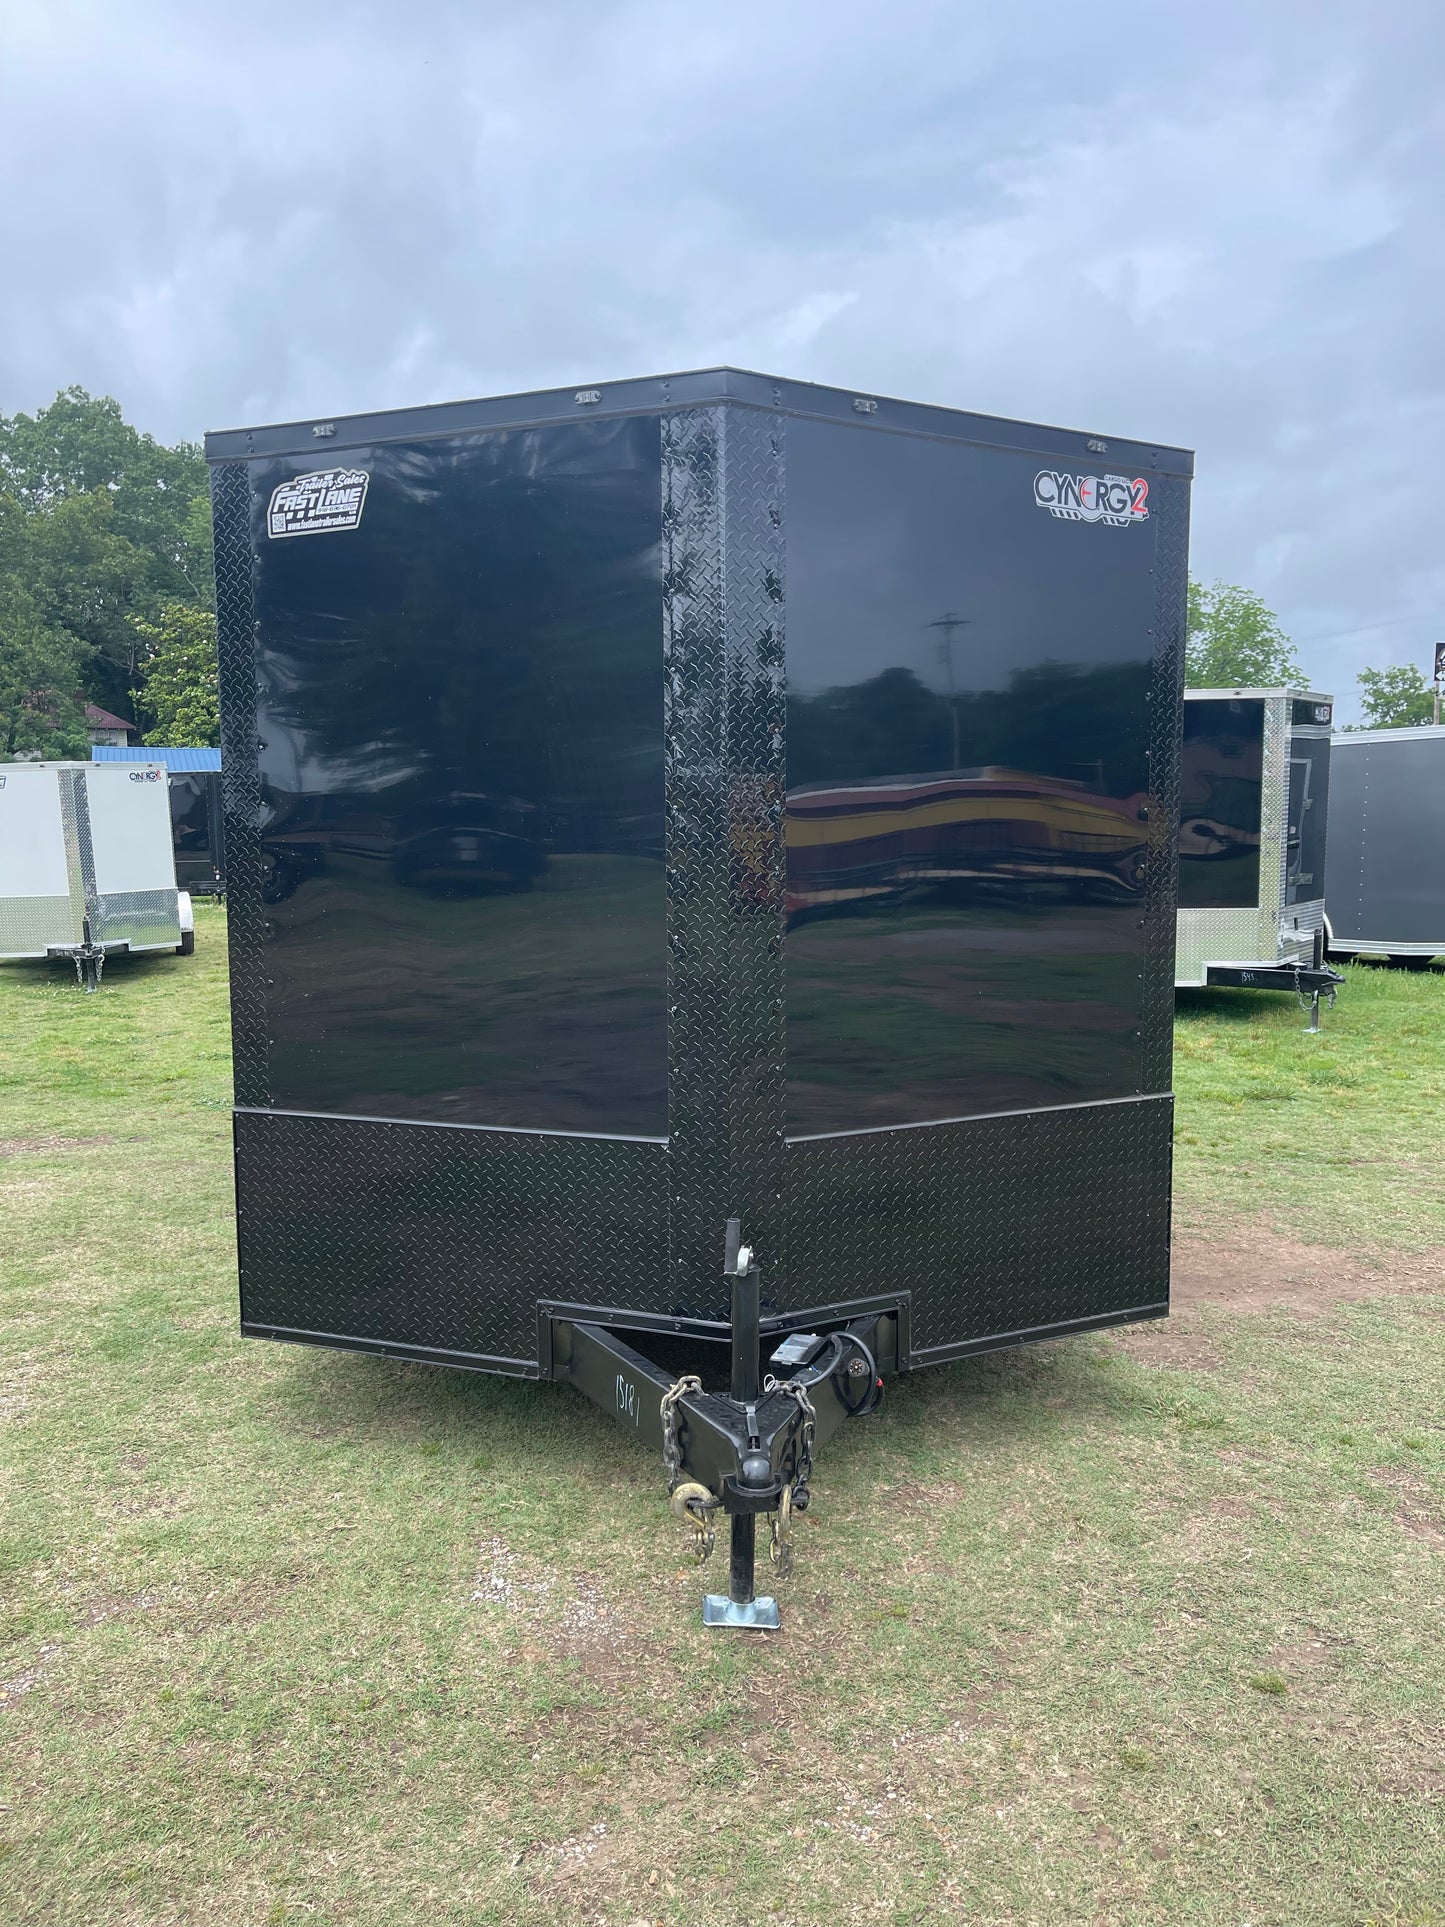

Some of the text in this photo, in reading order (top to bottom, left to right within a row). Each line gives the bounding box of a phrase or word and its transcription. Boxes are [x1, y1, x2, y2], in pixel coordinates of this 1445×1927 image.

[298, 473, 366, 492] Trailer Sales
[273, 487, 362, 514] FAST LANE
